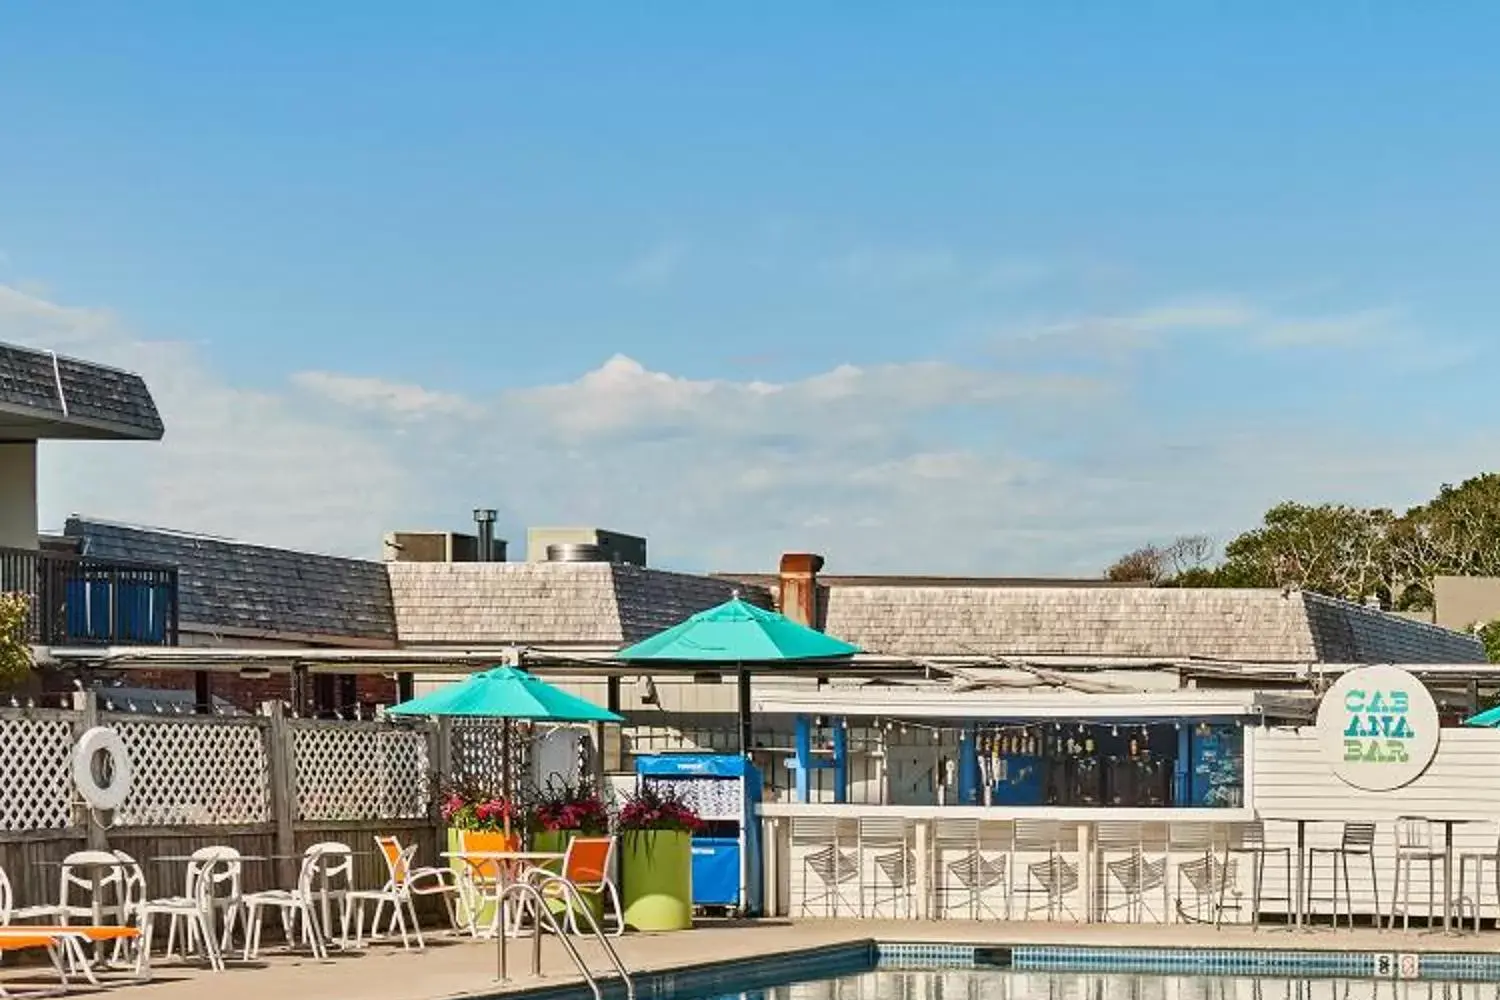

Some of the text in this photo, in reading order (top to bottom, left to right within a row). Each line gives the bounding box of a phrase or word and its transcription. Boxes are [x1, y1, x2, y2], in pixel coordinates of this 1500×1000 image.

[1344, 689, 1409, 713] CAB
[1344, 714, 1415, 737] ANA
[1344, 740, 1409, 762] BAR
